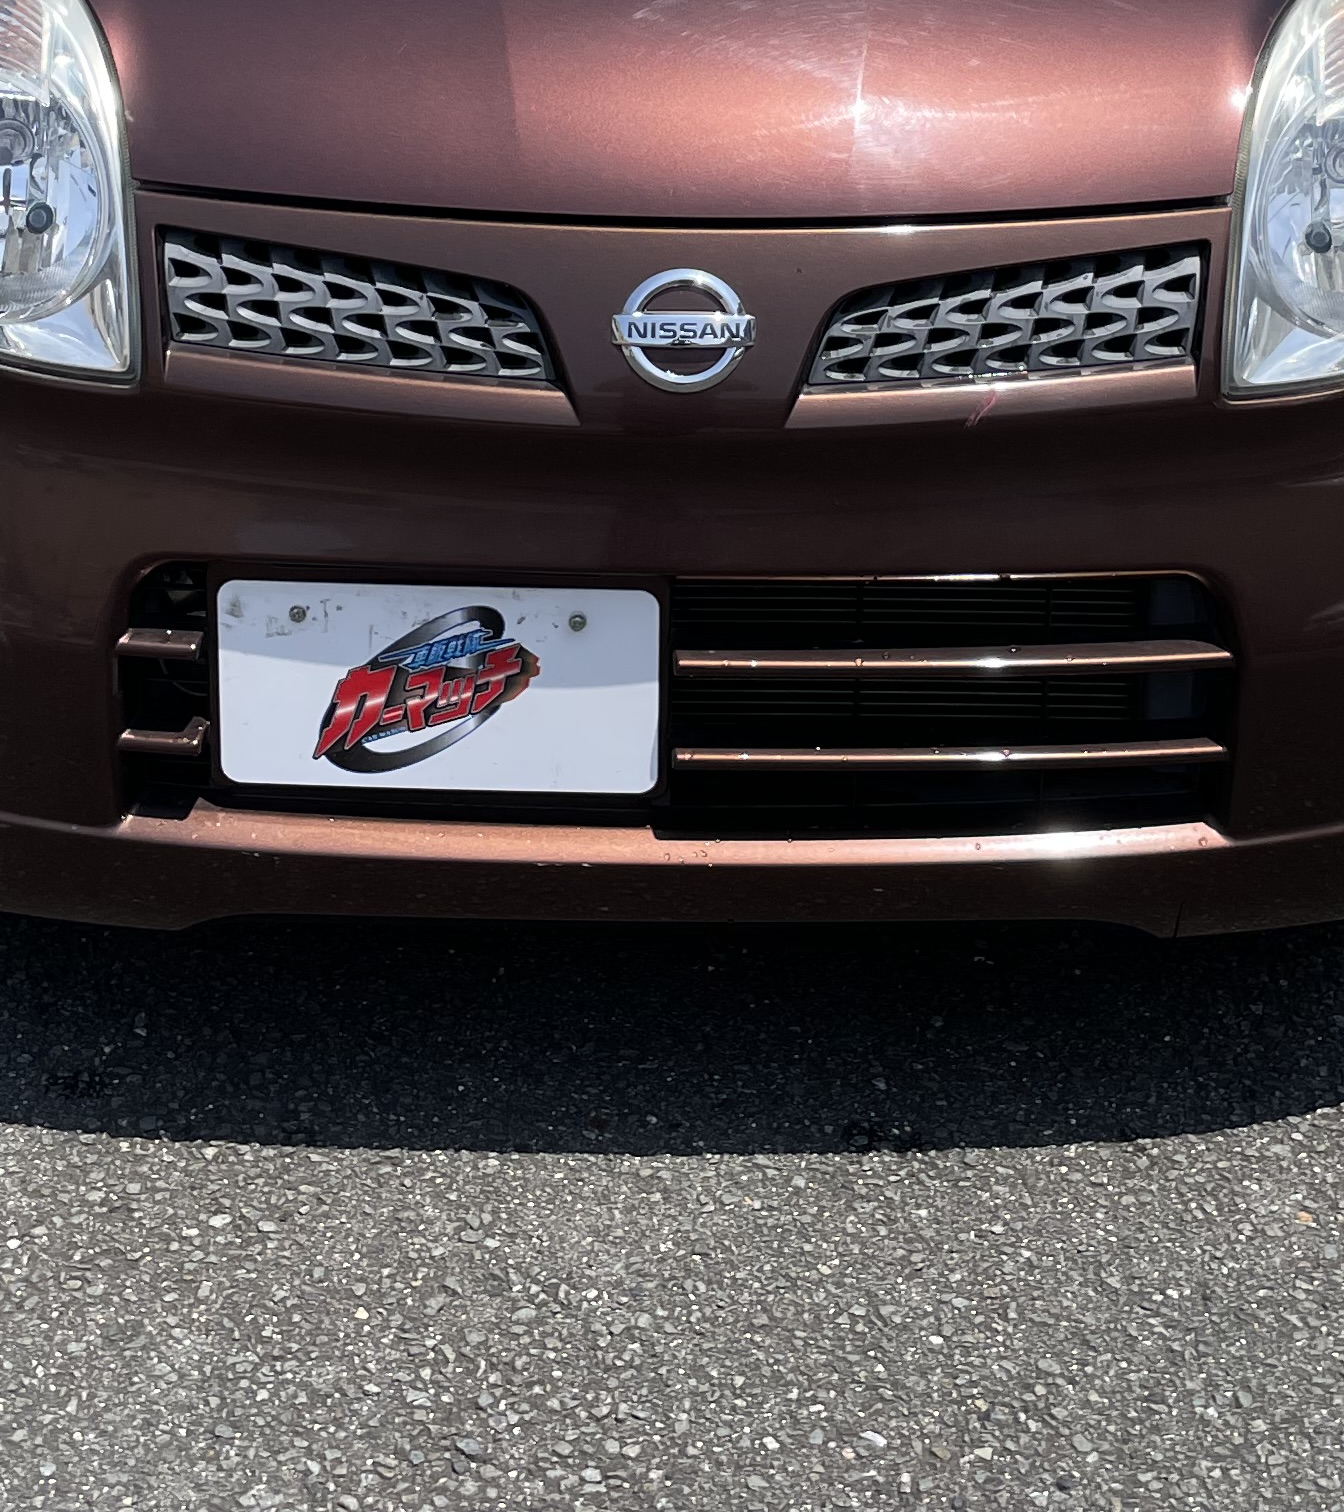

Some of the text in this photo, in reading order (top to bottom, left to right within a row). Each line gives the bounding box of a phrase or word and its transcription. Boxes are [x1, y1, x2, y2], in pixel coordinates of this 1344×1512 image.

[628, 322, 740, 338] NISSAN
[312, 643, 523, 760] カーマッチ
